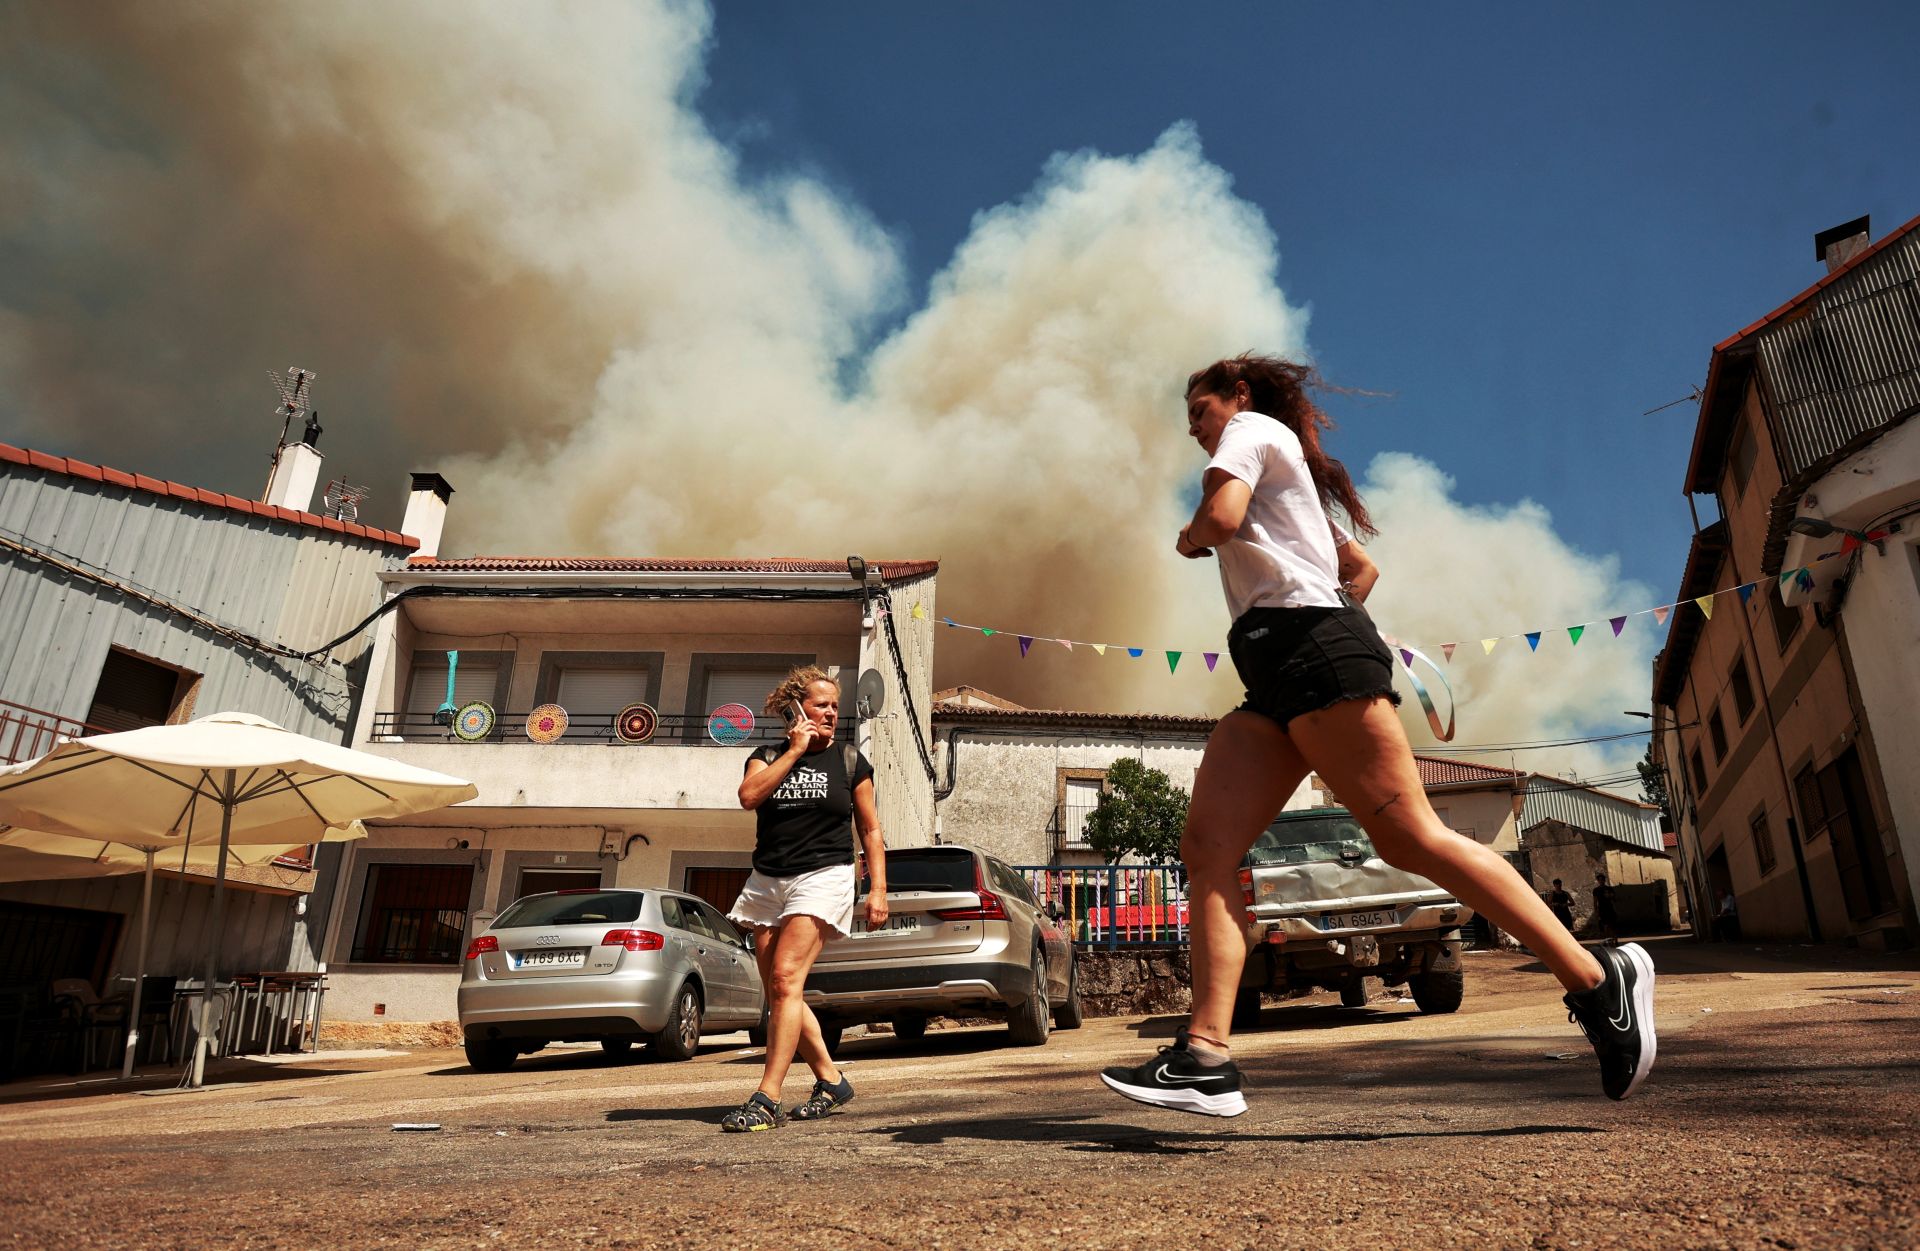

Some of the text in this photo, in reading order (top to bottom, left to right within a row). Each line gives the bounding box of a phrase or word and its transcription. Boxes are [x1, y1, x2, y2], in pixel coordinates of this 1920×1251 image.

[784, 771, 828, 784] ARIS
[892, 916, 917, 930] LNR
[1329, 911, 1395, 930] SA 6945 V
[524, 951, 581, 965] 4169 GXC
